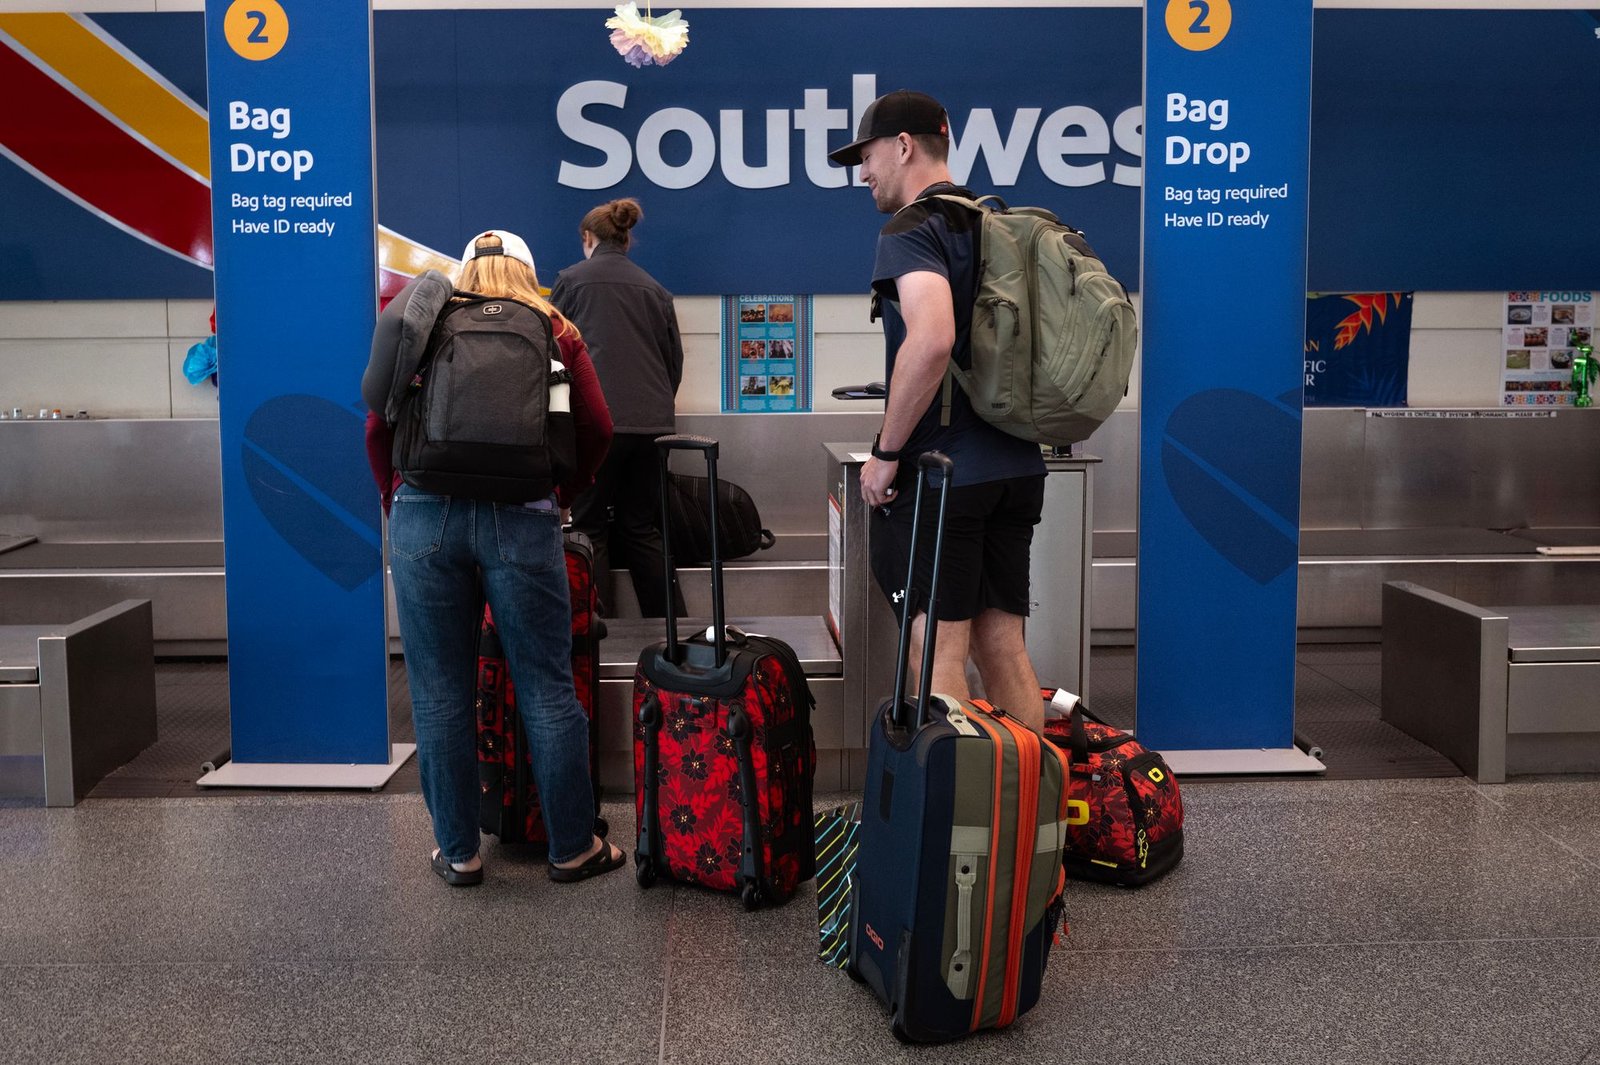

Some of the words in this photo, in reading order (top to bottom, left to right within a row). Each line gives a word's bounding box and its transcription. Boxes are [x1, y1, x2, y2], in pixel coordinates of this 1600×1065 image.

[246, 11, 269, 43] 2
[1188, 1, 1211, 33] 2
[229, 101, 291, 139] Bag
[1166, 93, 1229, 131] Bag
[230, 143, 314, 181] Drop
[1165, 136, 1251, 173] Drop
[231, 193, 260, 211] Bag
[263, 194, 287, 211] tag
[290, 192, 353, 211] required
[1165, 187, 1193, 204] Bag
[1197, 187, 1221, 204] tag
[1225, 183, 1288, 203] required
[232, 219, 270, 234] Have
[274, 219, 291, 234] ID
[294, 219, 336, 237] ready
[1164, 213, 1203, 227] Have
[1207, 212, 1224, 227] ID
[1228, 211, 1270, 229] ready
[739, 294, 794, 303] CELEBRATIONS
[1540, 291, 1592, 303] FOODS
